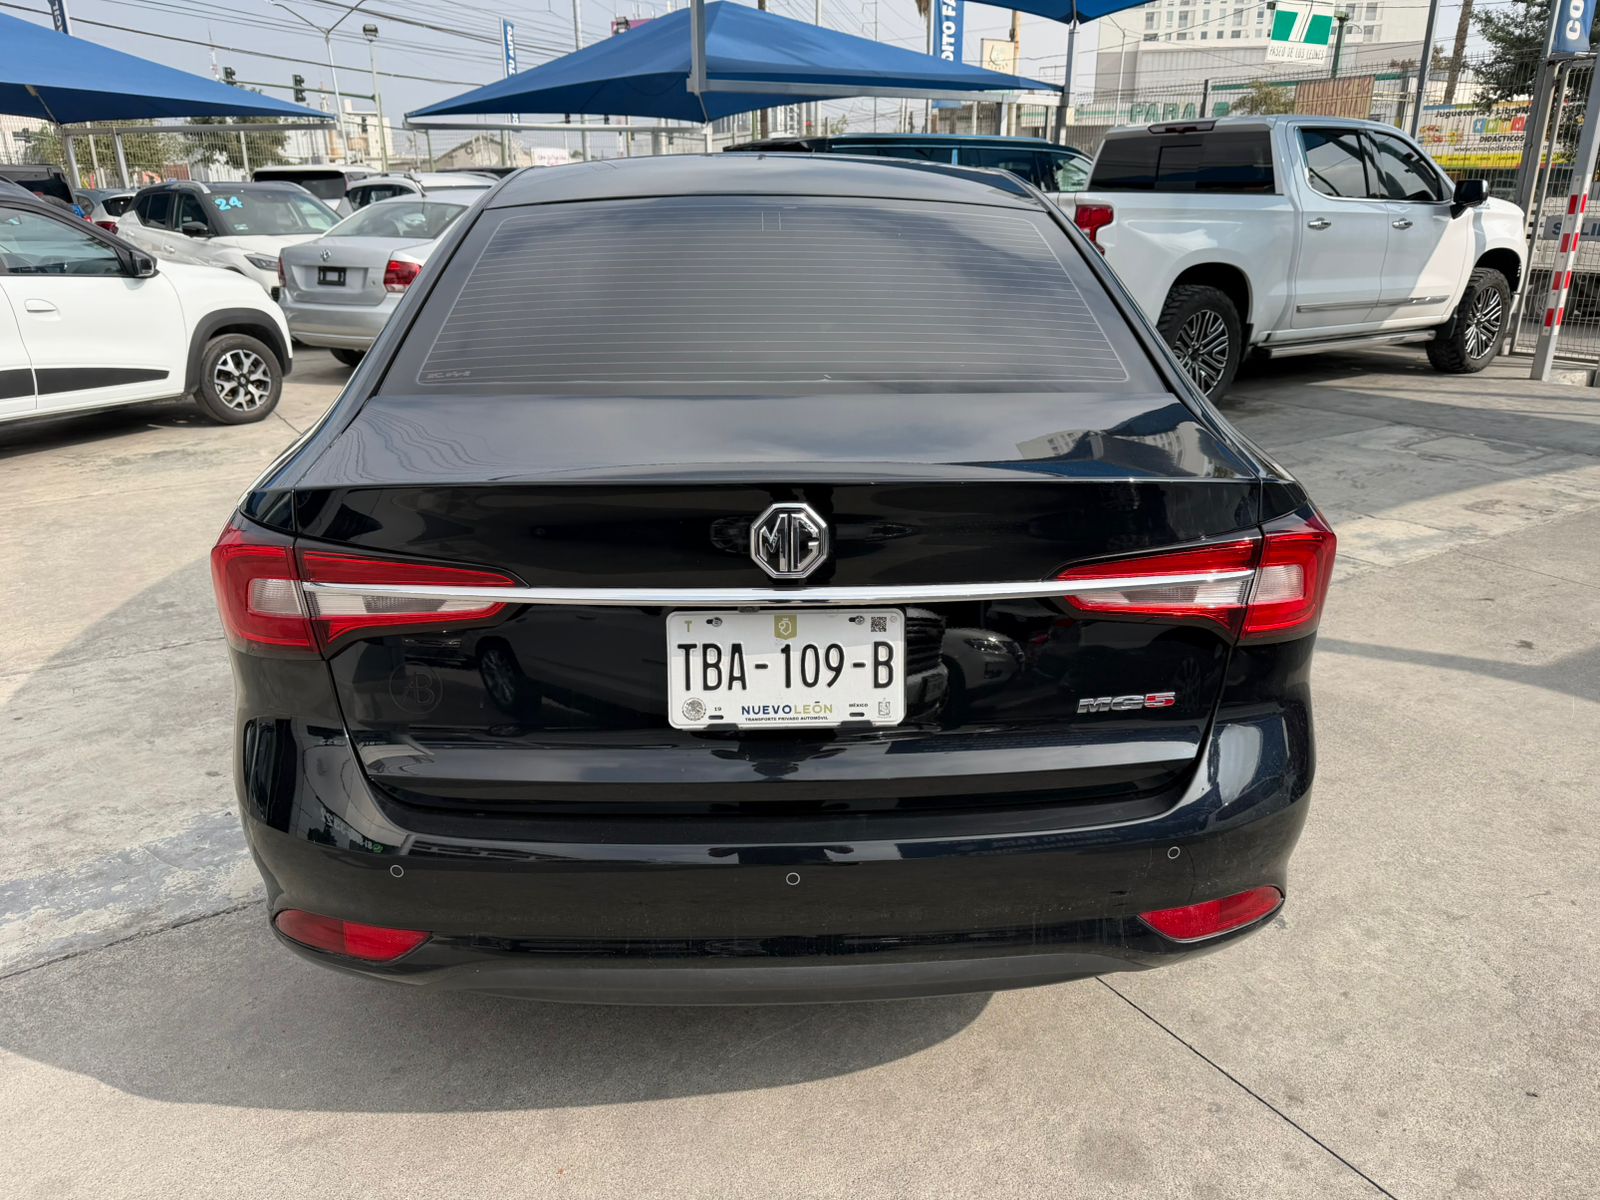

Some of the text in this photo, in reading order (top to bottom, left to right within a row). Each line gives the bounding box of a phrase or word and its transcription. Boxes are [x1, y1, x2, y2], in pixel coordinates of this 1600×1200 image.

[1269, 46, 1285, 57] PASEO
[1287, 48, 1293, 57] DE
[1295, 48, 1304, 58] LOS
[215, 196, 243, 210] 24
[759, 513, 819, 572] MG
[684, 620, 692, 632] T
[677, 641, 894, 691] TBA-109-B
[1077, 692, 1176, 713] MG5
